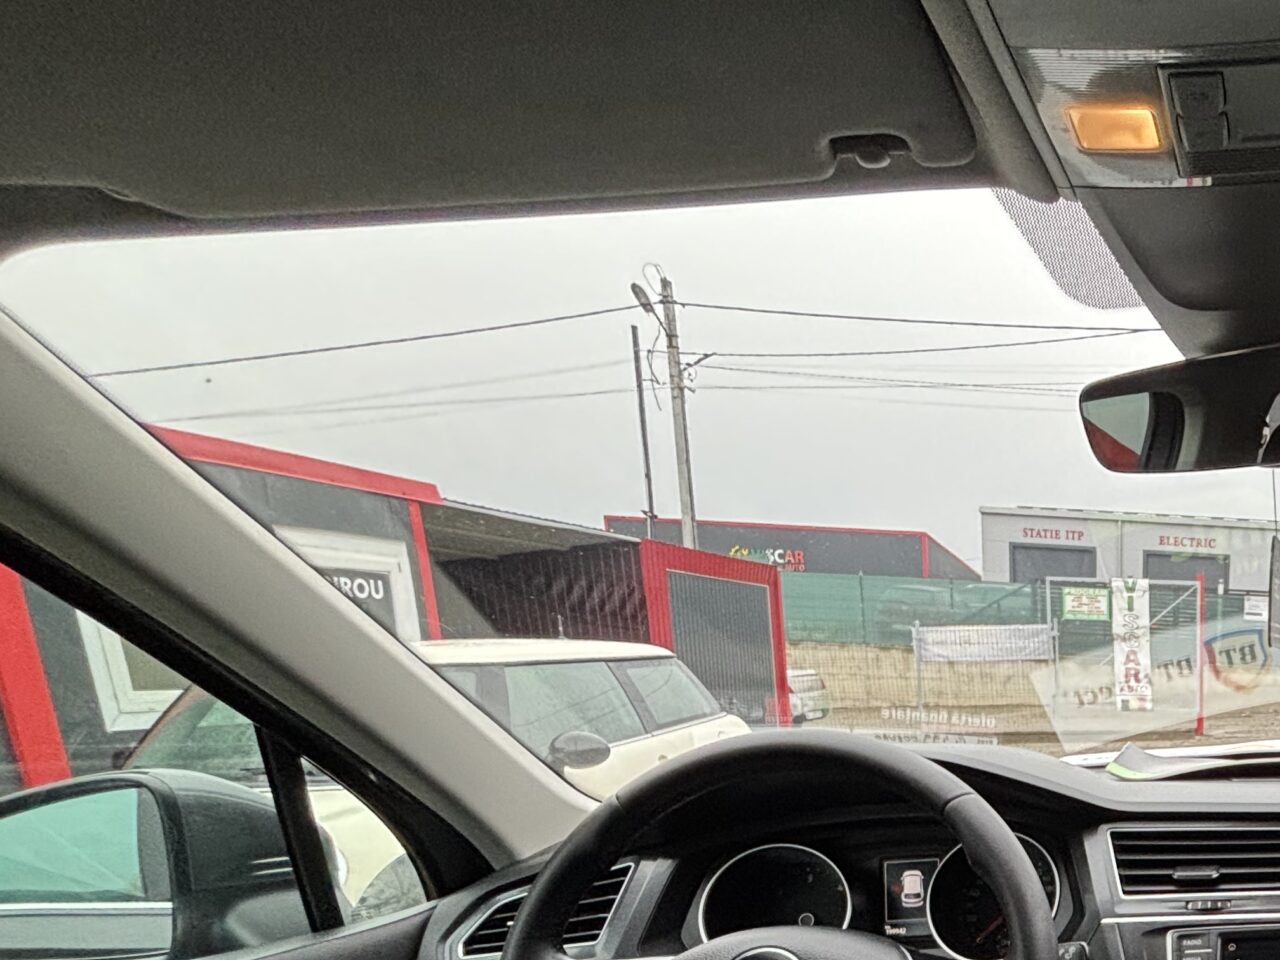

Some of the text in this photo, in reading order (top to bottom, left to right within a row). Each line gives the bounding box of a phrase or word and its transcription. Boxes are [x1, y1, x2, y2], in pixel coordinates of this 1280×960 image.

[1022, 528, 1084, 541] STATIE ITP
[1158, 535, 1217, 548] ELECTRIC
